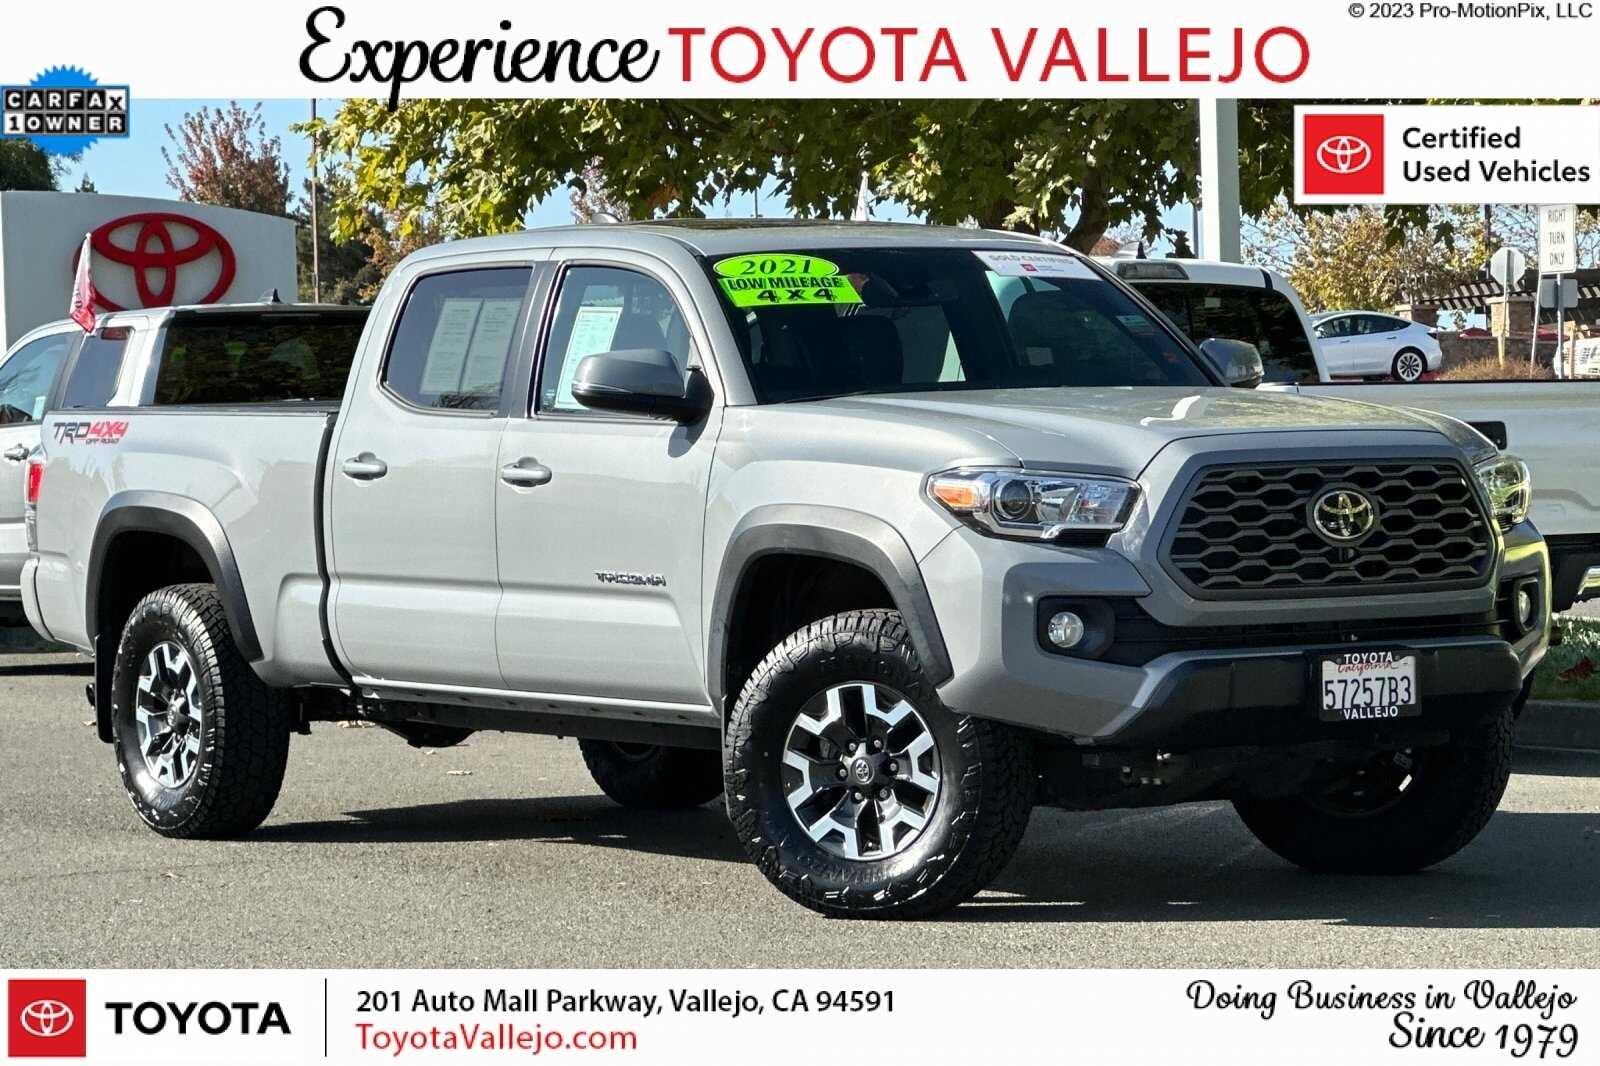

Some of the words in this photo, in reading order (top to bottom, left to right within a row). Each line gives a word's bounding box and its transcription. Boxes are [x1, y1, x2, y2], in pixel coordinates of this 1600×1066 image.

[1547, 209, 1567, 224] RIGHT
[1549, 231, 1565, 245] TURN
[1549, 252, 1565, 266] ONLY
[740, 259, 812, 275] 2021
[728, 277, 764, 290] LOW
[768, 276, 844, 289] MILEAGE
[54, 422, 91, 444] TRD
[1344, 651, 1394, 665] TOYOTA
[1324, 676, 1412, 709] 57257B3
[1343, 706, 1399, 720] VALLEJO
